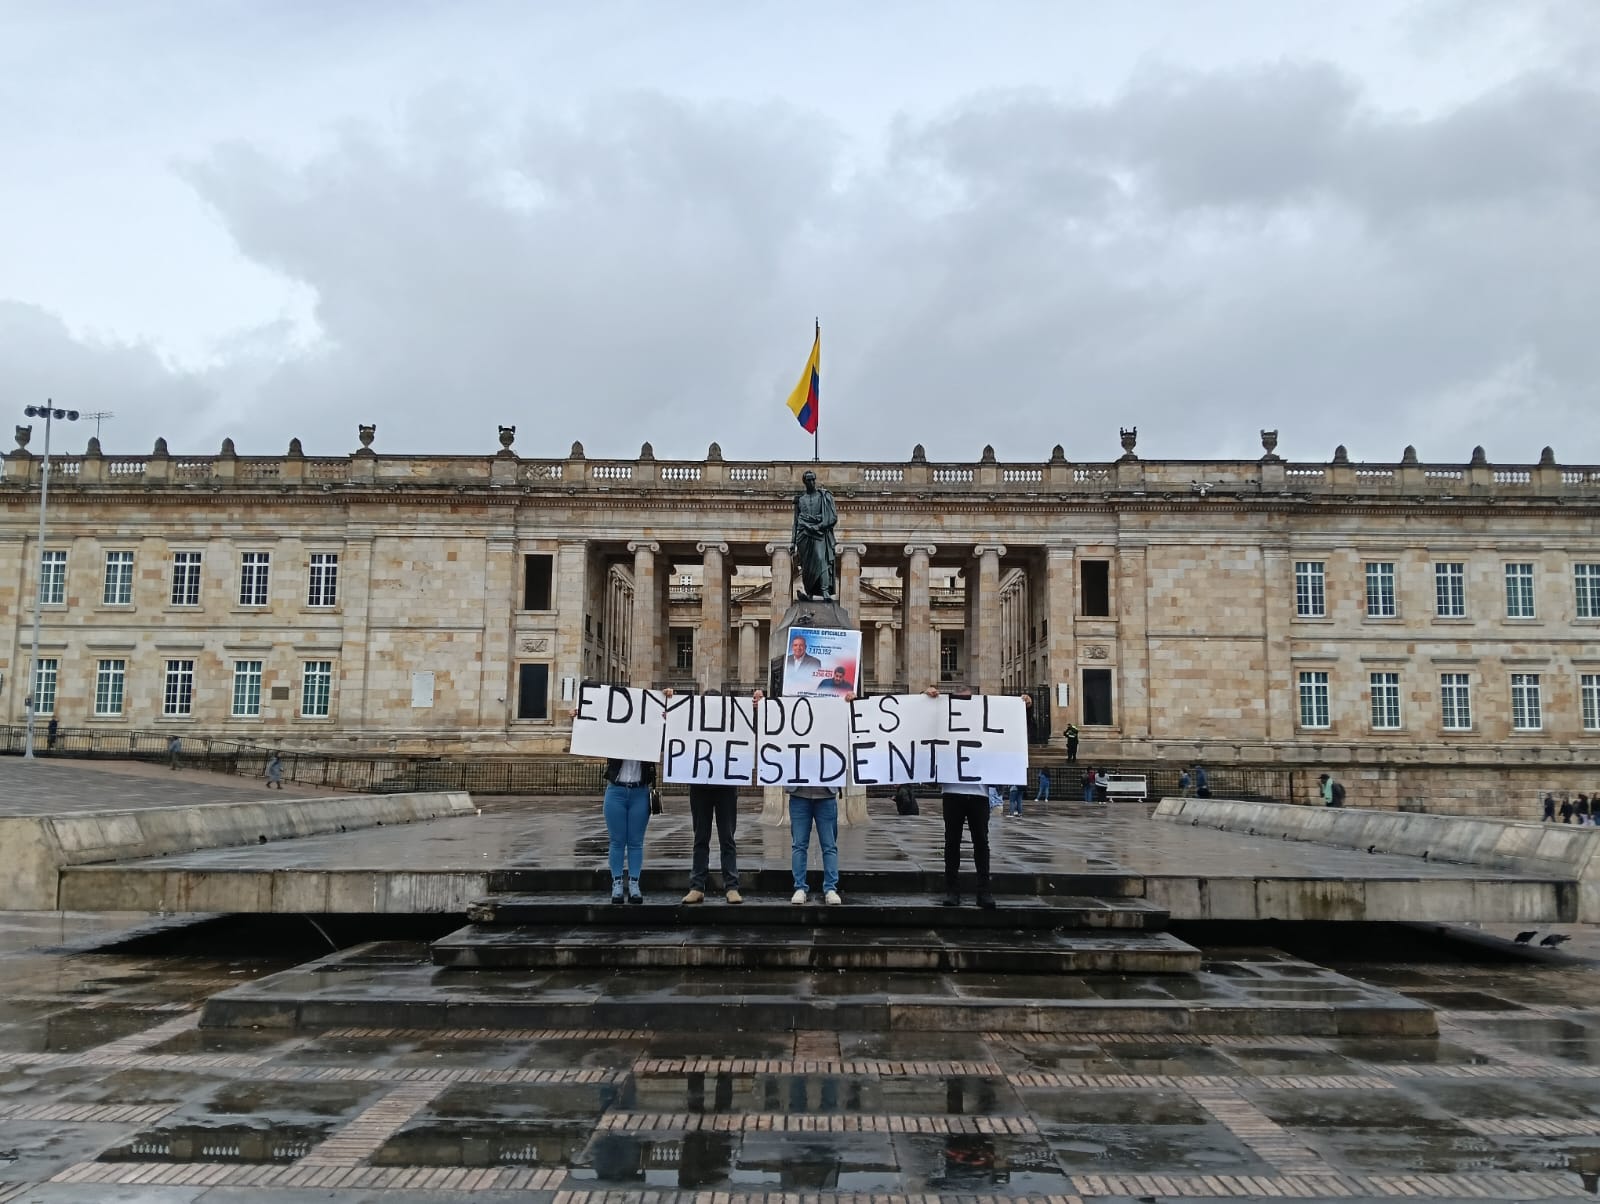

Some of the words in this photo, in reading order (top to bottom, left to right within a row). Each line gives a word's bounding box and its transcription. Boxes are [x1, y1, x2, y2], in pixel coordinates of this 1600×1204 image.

[577, 683, 813, 737] EDMUNDO
[850, 695, 900, 734] ES
[947, 694, 1005, 734] EL
[667, 739, 983, 784] PRESIDENTE
